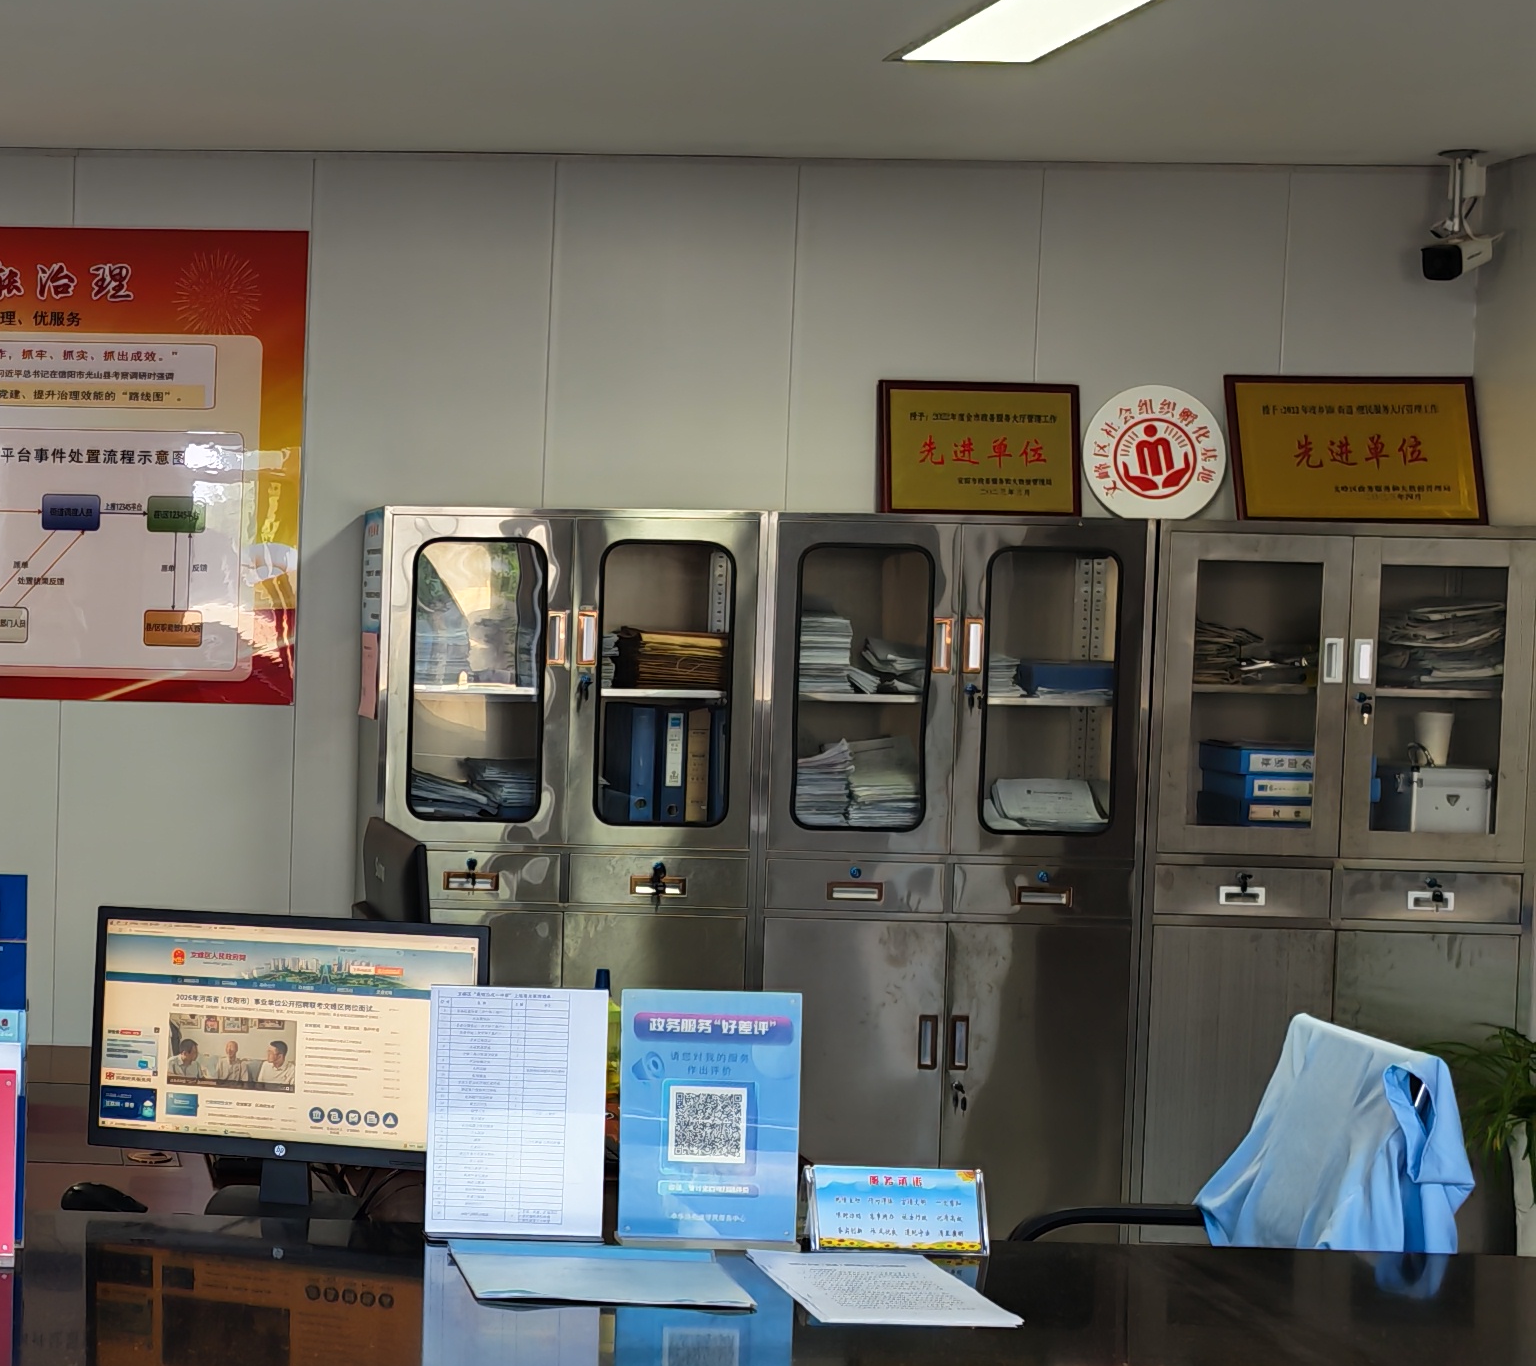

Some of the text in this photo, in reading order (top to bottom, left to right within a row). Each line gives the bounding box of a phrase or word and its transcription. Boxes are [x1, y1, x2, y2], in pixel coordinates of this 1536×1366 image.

[919, 435, 1048, 469] 先进单位
[1294, 434, 1428, 469] 先进单位
